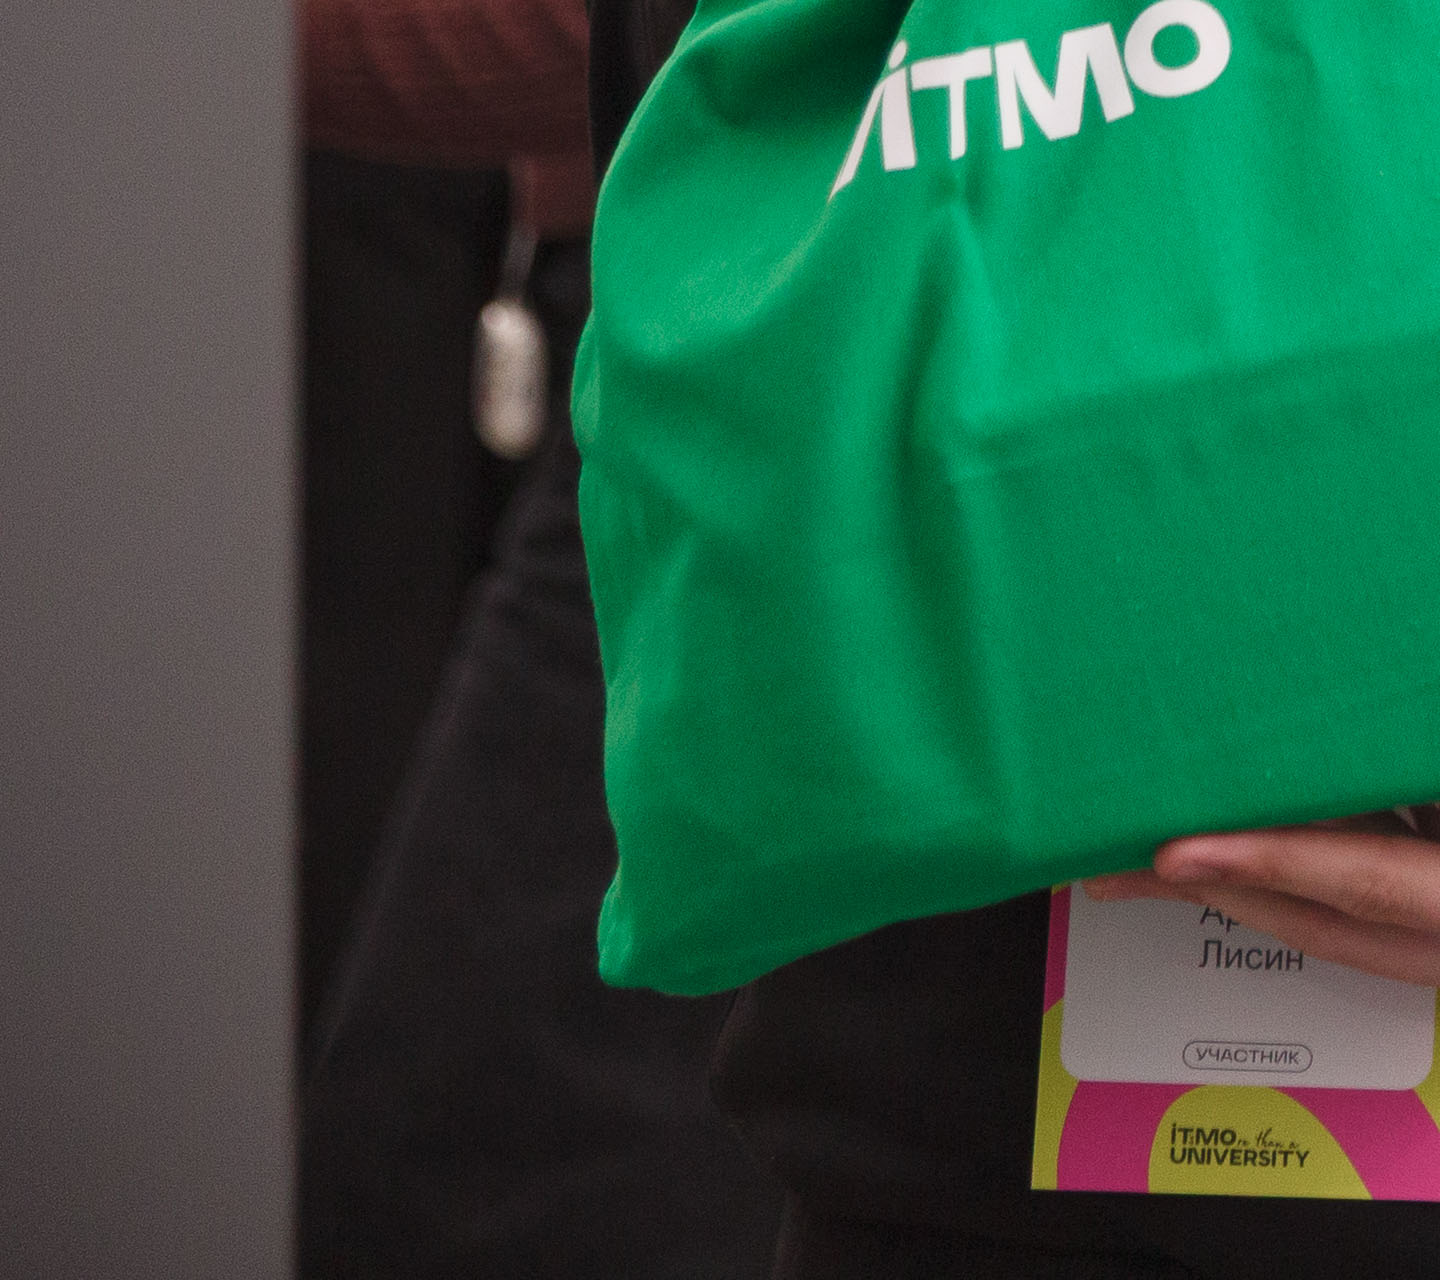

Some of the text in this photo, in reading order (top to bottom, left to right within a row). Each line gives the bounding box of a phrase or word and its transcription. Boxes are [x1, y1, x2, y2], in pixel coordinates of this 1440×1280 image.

[1199, 940, 1303, 971] Лисин
[1196, 1048, 1300, 1064] УЧАСТНИК
[1170, 1147, 1311, 1168] UNIVERSITY
